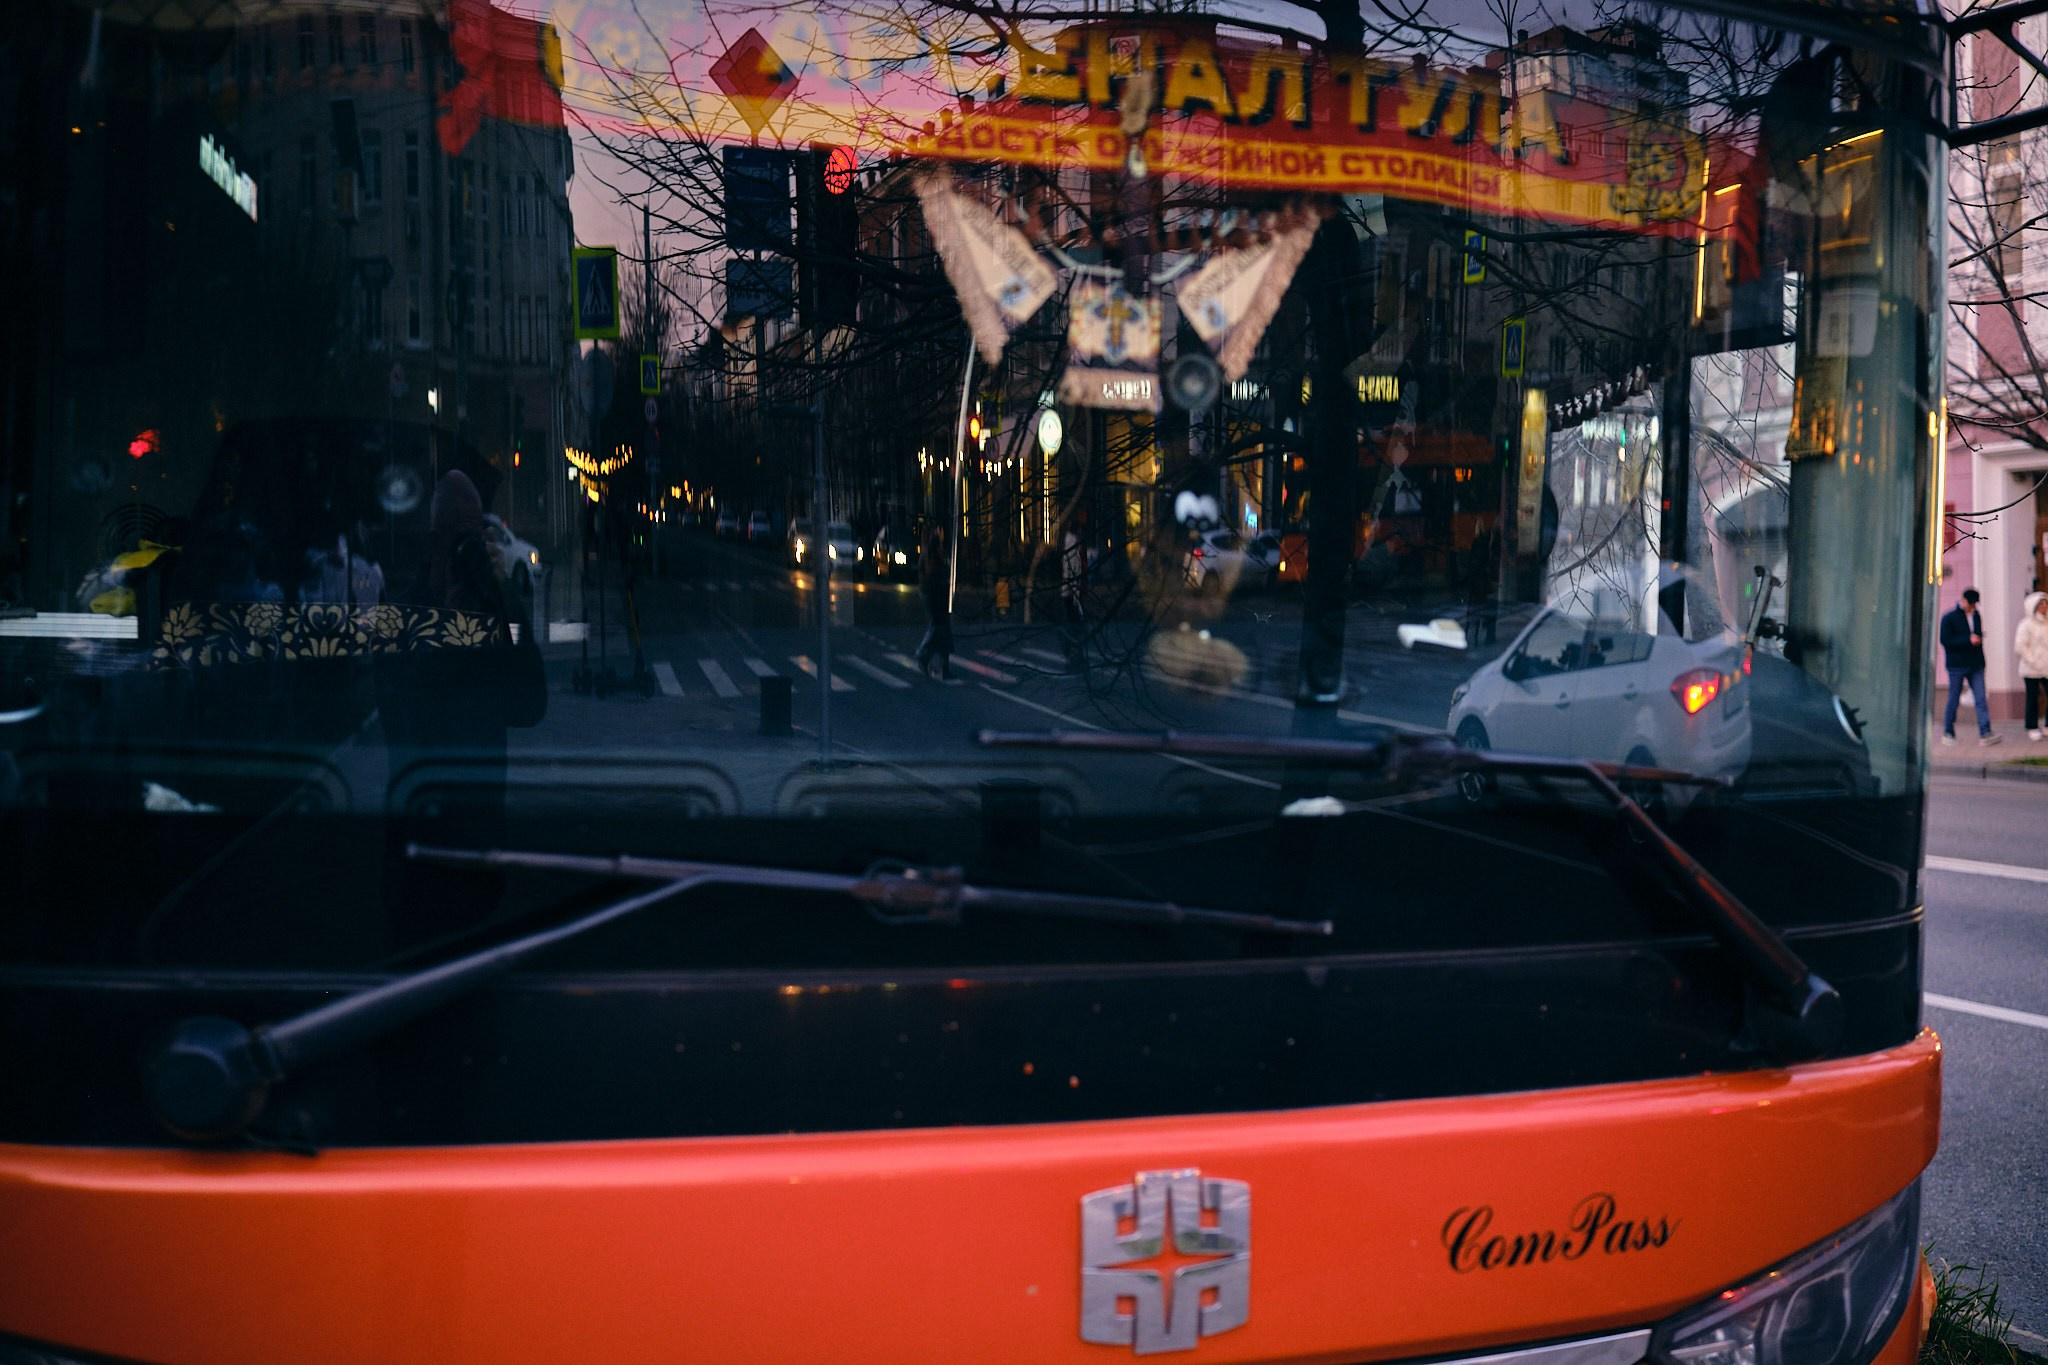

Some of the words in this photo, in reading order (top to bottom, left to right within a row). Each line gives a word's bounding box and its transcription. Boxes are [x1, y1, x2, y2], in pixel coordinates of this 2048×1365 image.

[1328, 52, 1567, 160] ТУЛА
[1340, 149, 1499, 197] СТОЛИЦЫ
[1441, 1192, 1682, 1274] ComPass
